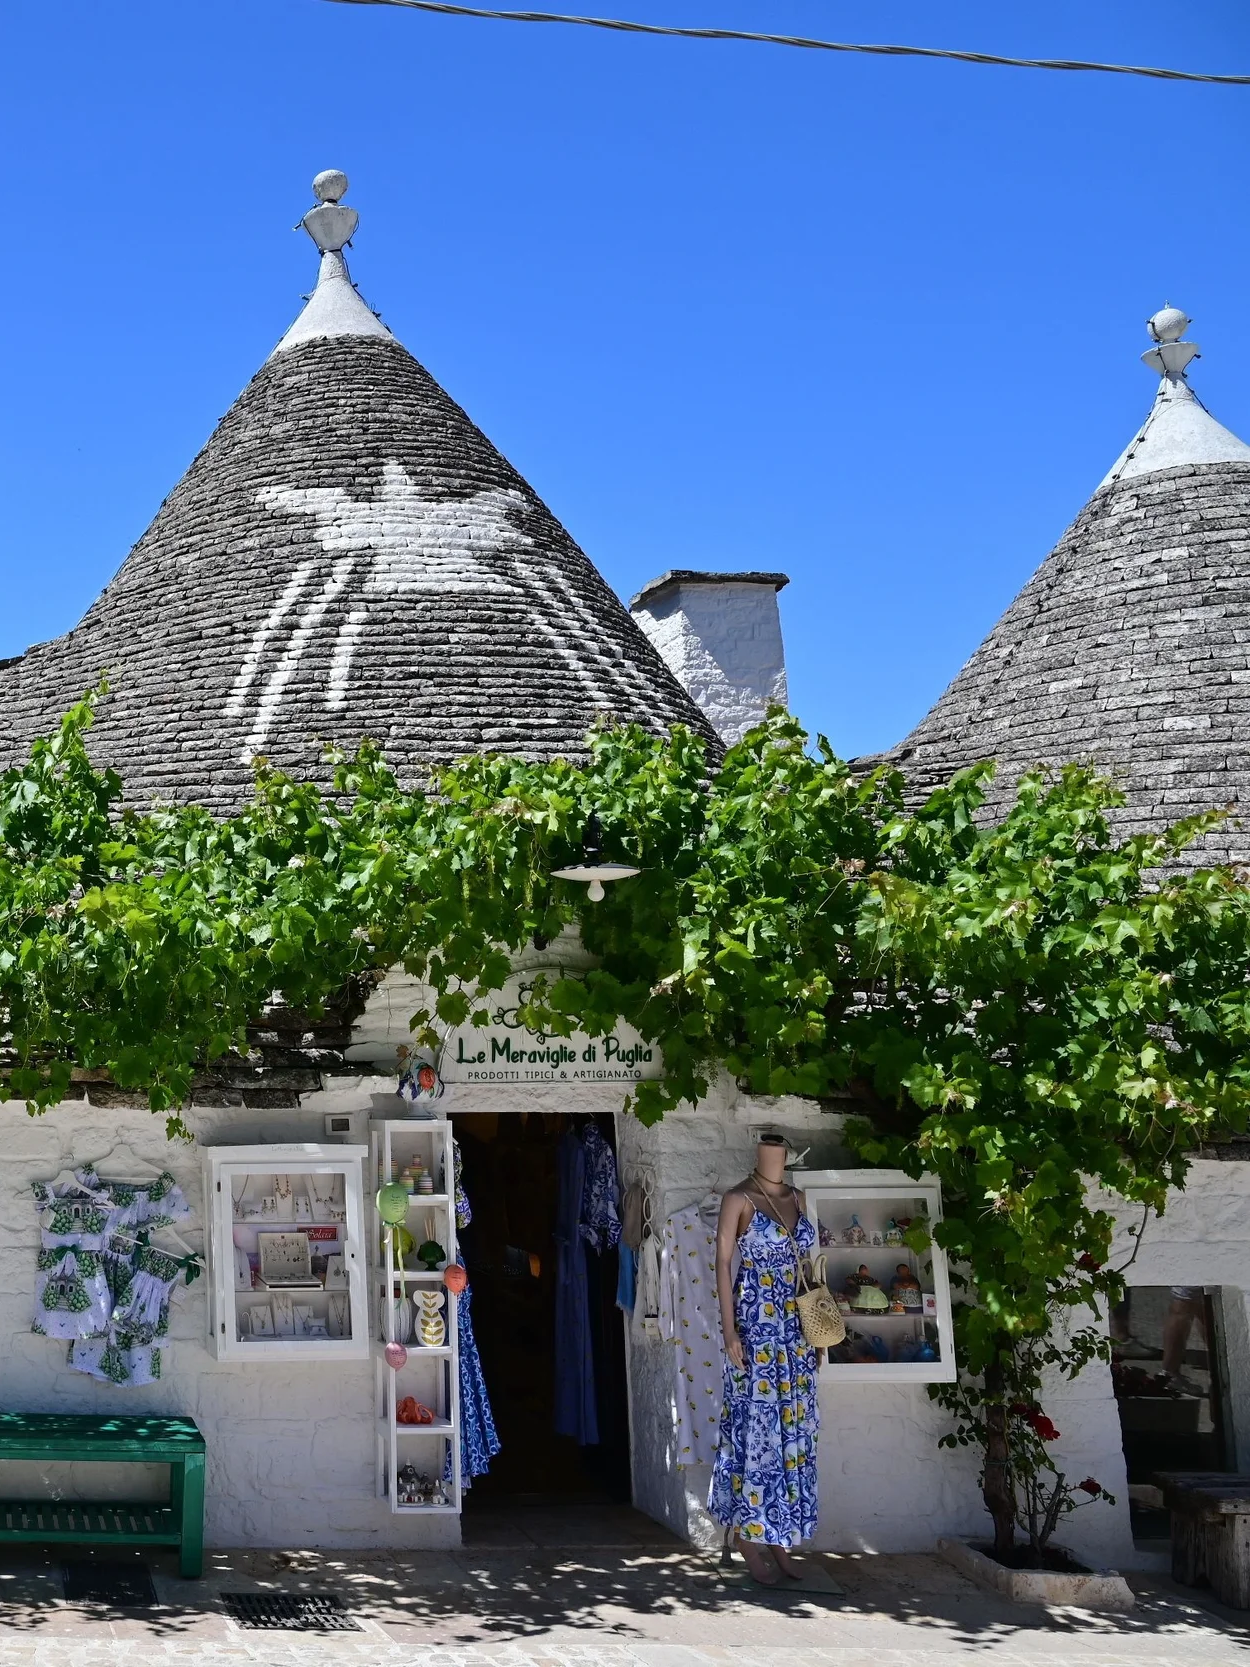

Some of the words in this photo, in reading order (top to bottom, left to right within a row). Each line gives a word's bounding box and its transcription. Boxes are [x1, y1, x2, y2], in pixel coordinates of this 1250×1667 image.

[456, 1037, 486, 1064] Le
[491, 1037, 576, 1069] Meraviglie
[582, 1043, 596, 1062] di
[602, 1036, 652, 1068] Puglia
[468, 1071, 519, 1080] PRODOTTI
[525, 1070, 554, 1079] TIPICI
[559, 1070, 568, 1079] &
[573, 1069, 642, 1079] ARTIGIANATO
